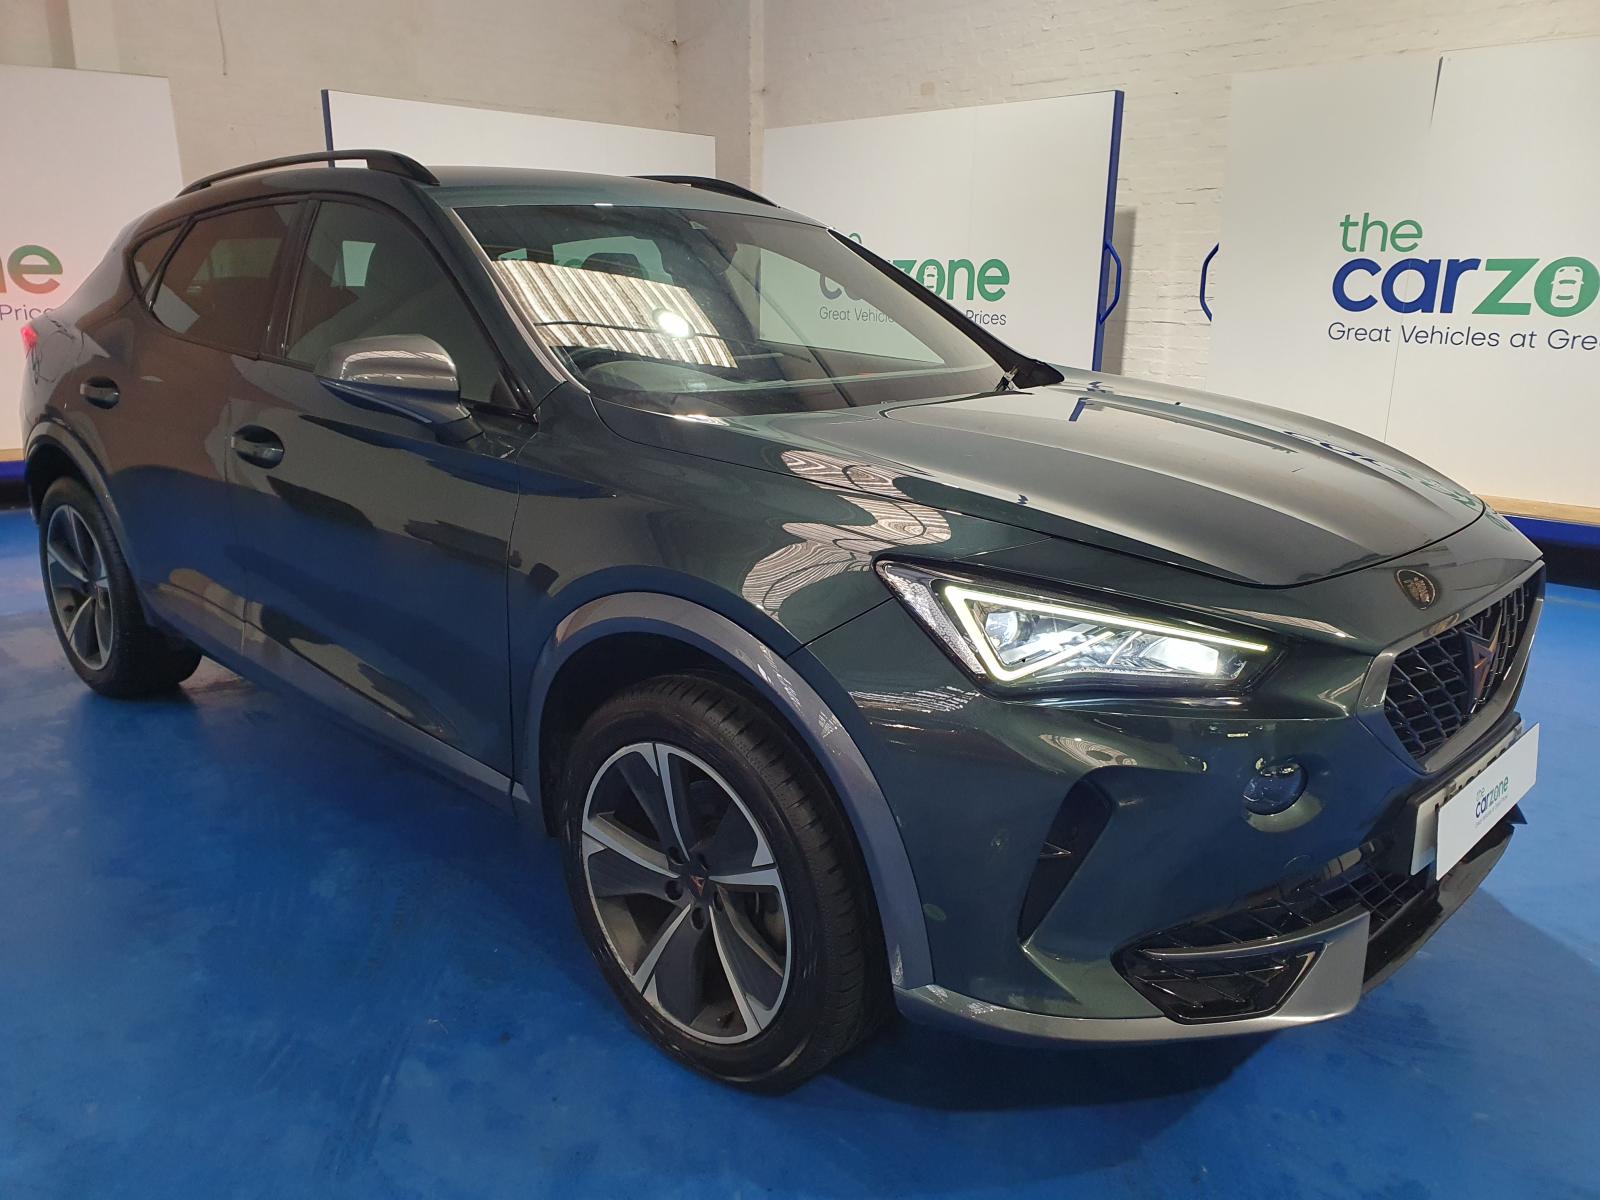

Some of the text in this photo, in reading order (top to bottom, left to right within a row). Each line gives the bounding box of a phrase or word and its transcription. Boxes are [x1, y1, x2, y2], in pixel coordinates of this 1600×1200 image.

[1339, 212, 1423, 253] the
[0, 245, 63, 294] e
[820, 259, 1010, 302] cone
[0, 304, 53, 320] Pric
[820, 306, 850, 320] Great
[966, 310, 1007, 325] Prices
[1328, 322, 1600, 351] Great Vehicles at Gre
[1475, 776, 1509, 818] carzone
